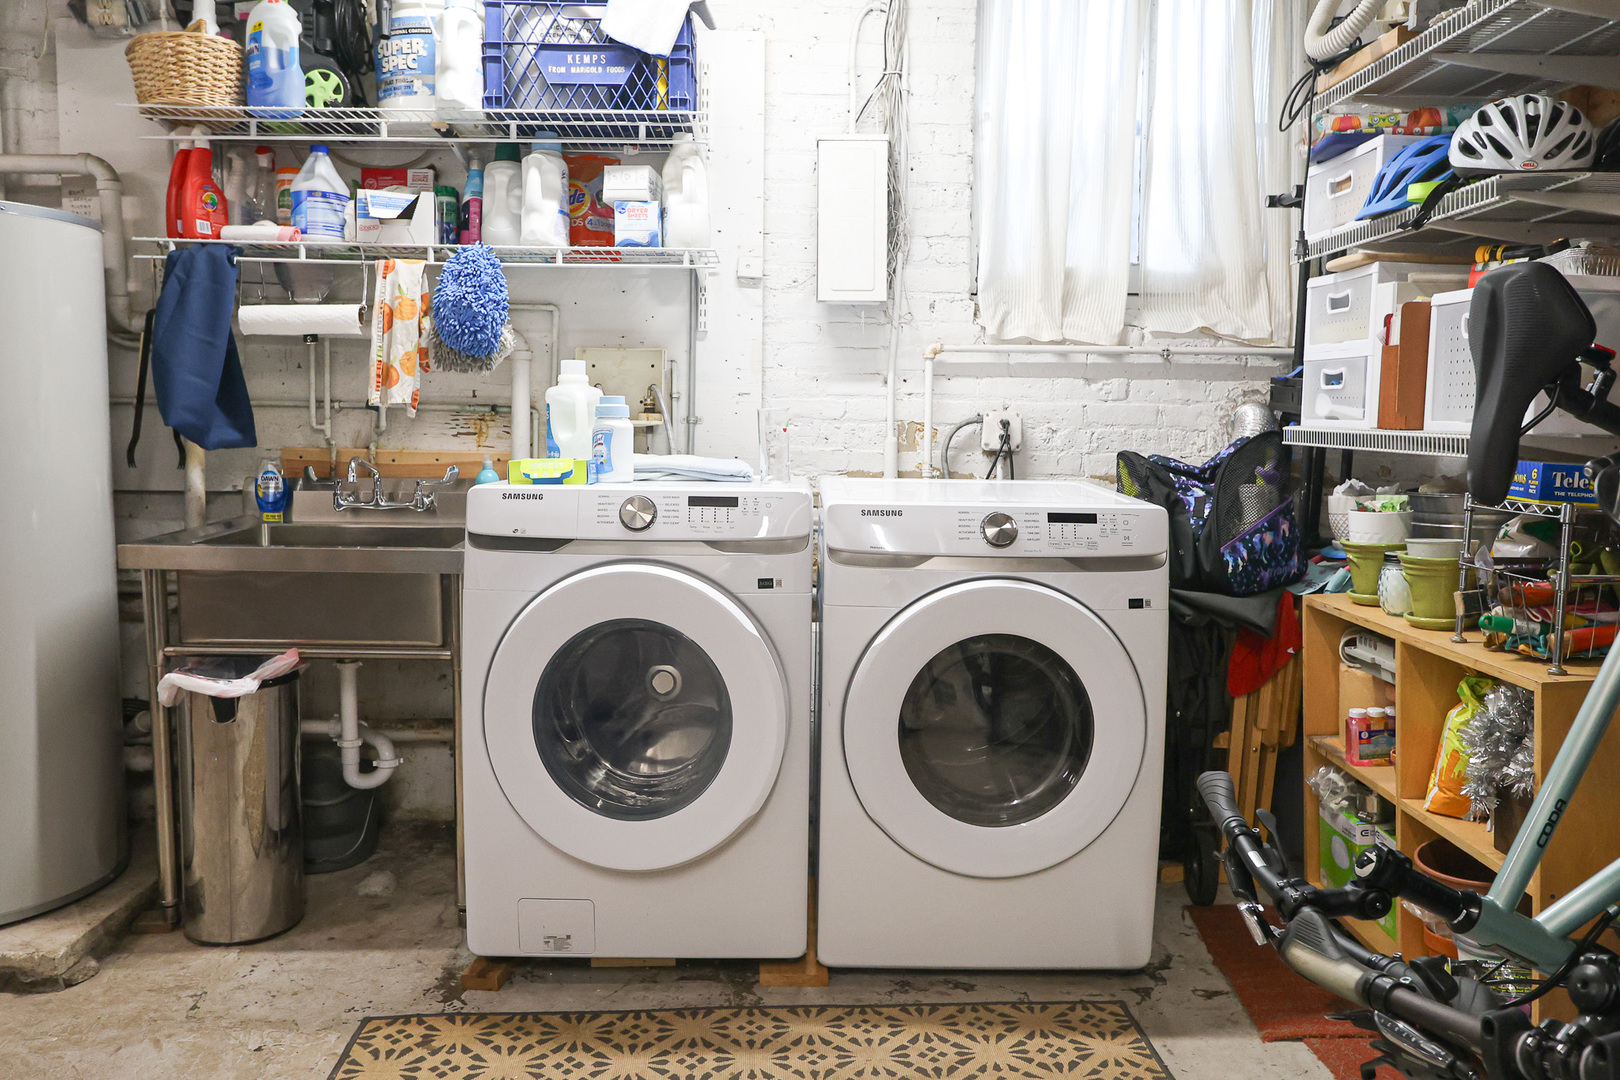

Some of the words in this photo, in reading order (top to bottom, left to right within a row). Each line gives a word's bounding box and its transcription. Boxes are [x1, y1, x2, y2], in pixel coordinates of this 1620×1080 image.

[378, 38, 427, 59] SUPER
[381, 54, 418, 73] SPEC
[567, 54, 606, 64] KEMPS
[569, 188, 586, 206] de
[586, 218, 593, 226] 4
[1532, 468, 1538, 479] 6
[502, 492, 544, 500] SAMSUNG
[1536, 798, 1567, 849] CODA
